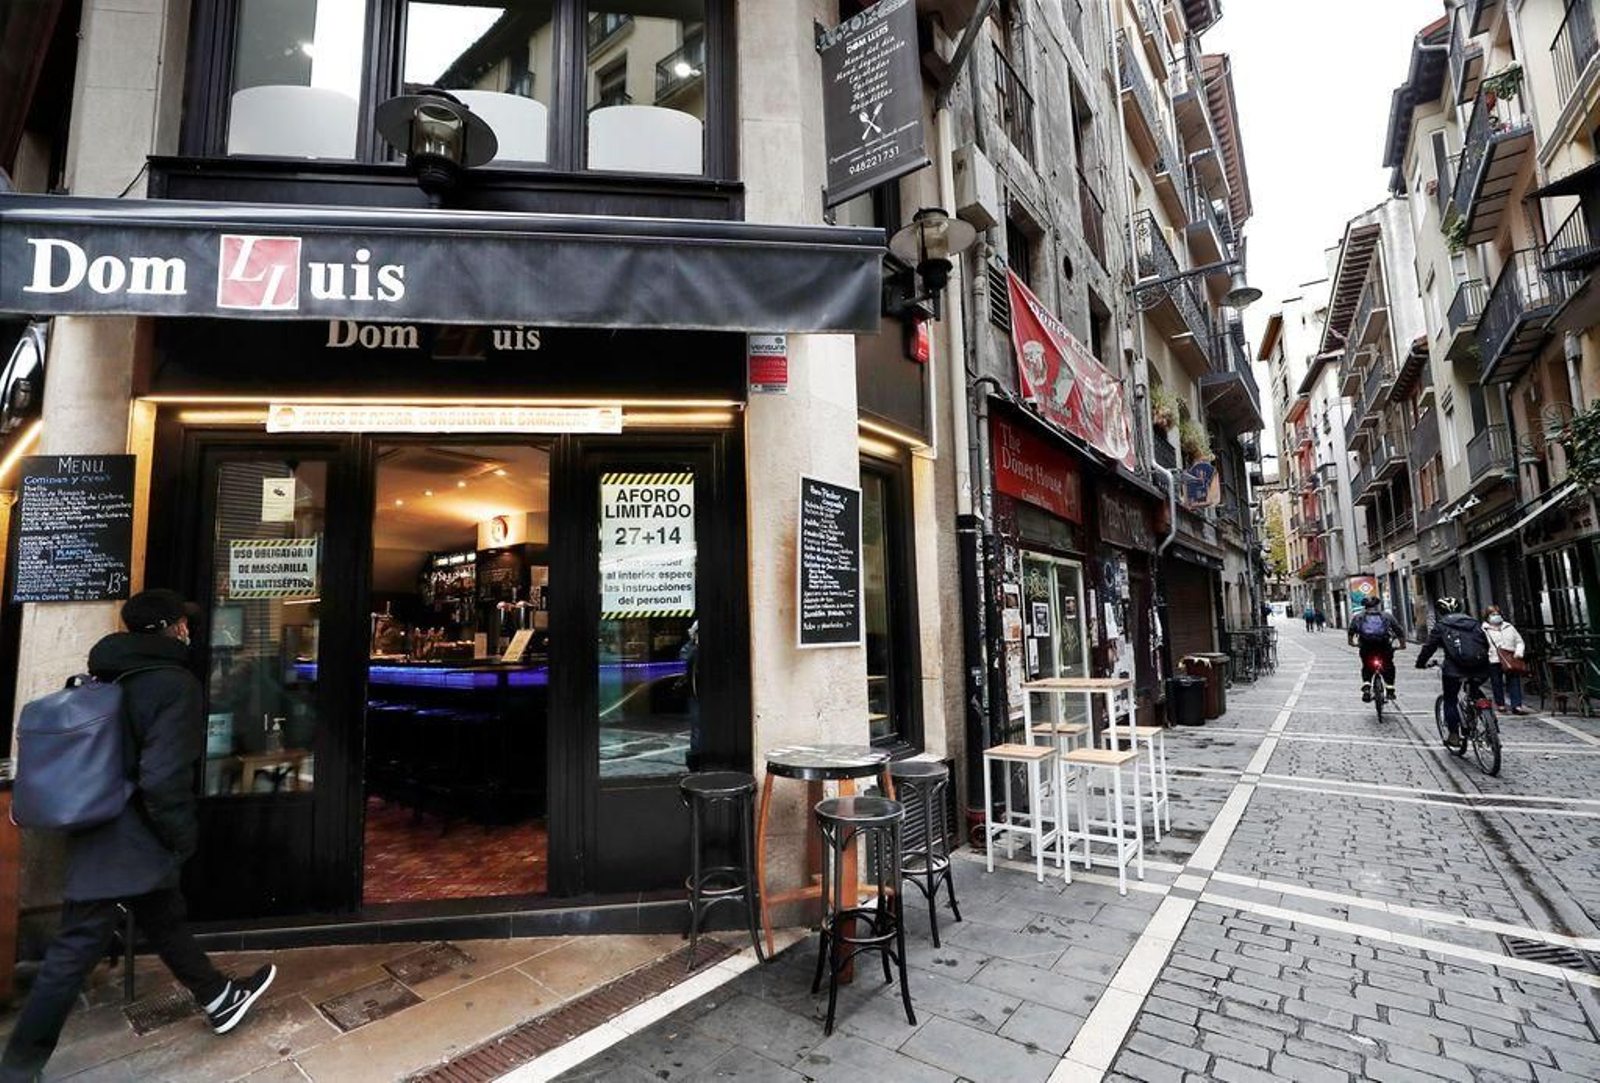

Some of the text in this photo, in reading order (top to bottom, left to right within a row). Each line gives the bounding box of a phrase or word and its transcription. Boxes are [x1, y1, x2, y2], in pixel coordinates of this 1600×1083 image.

[868, 24, 889, 42] LLUIS
[867, 42, 879, 55] del
[23, 238, 187, 295] Dom
[326, 319, 420, 349] Dom
[1000, 422, 1021, 454] The
[1002, 446, 1062, 495] Döner House
[616, 488, 680, 503] AFORO
[605, 504, 691, 518] LIMITADO
[615, 526, 682, 545] 27+14
[254, 548, 313, 559] OBLIGATORIO
[238, 563, 308, 574] DE MASCARILLA
[606, 570, 616, 580] al
[658, 571, 693, 582] espere
[231, 580, 238, 590] Y
[605, 583, 692, 593] las instrucciones
[618, 595, 682, 610] del personal
